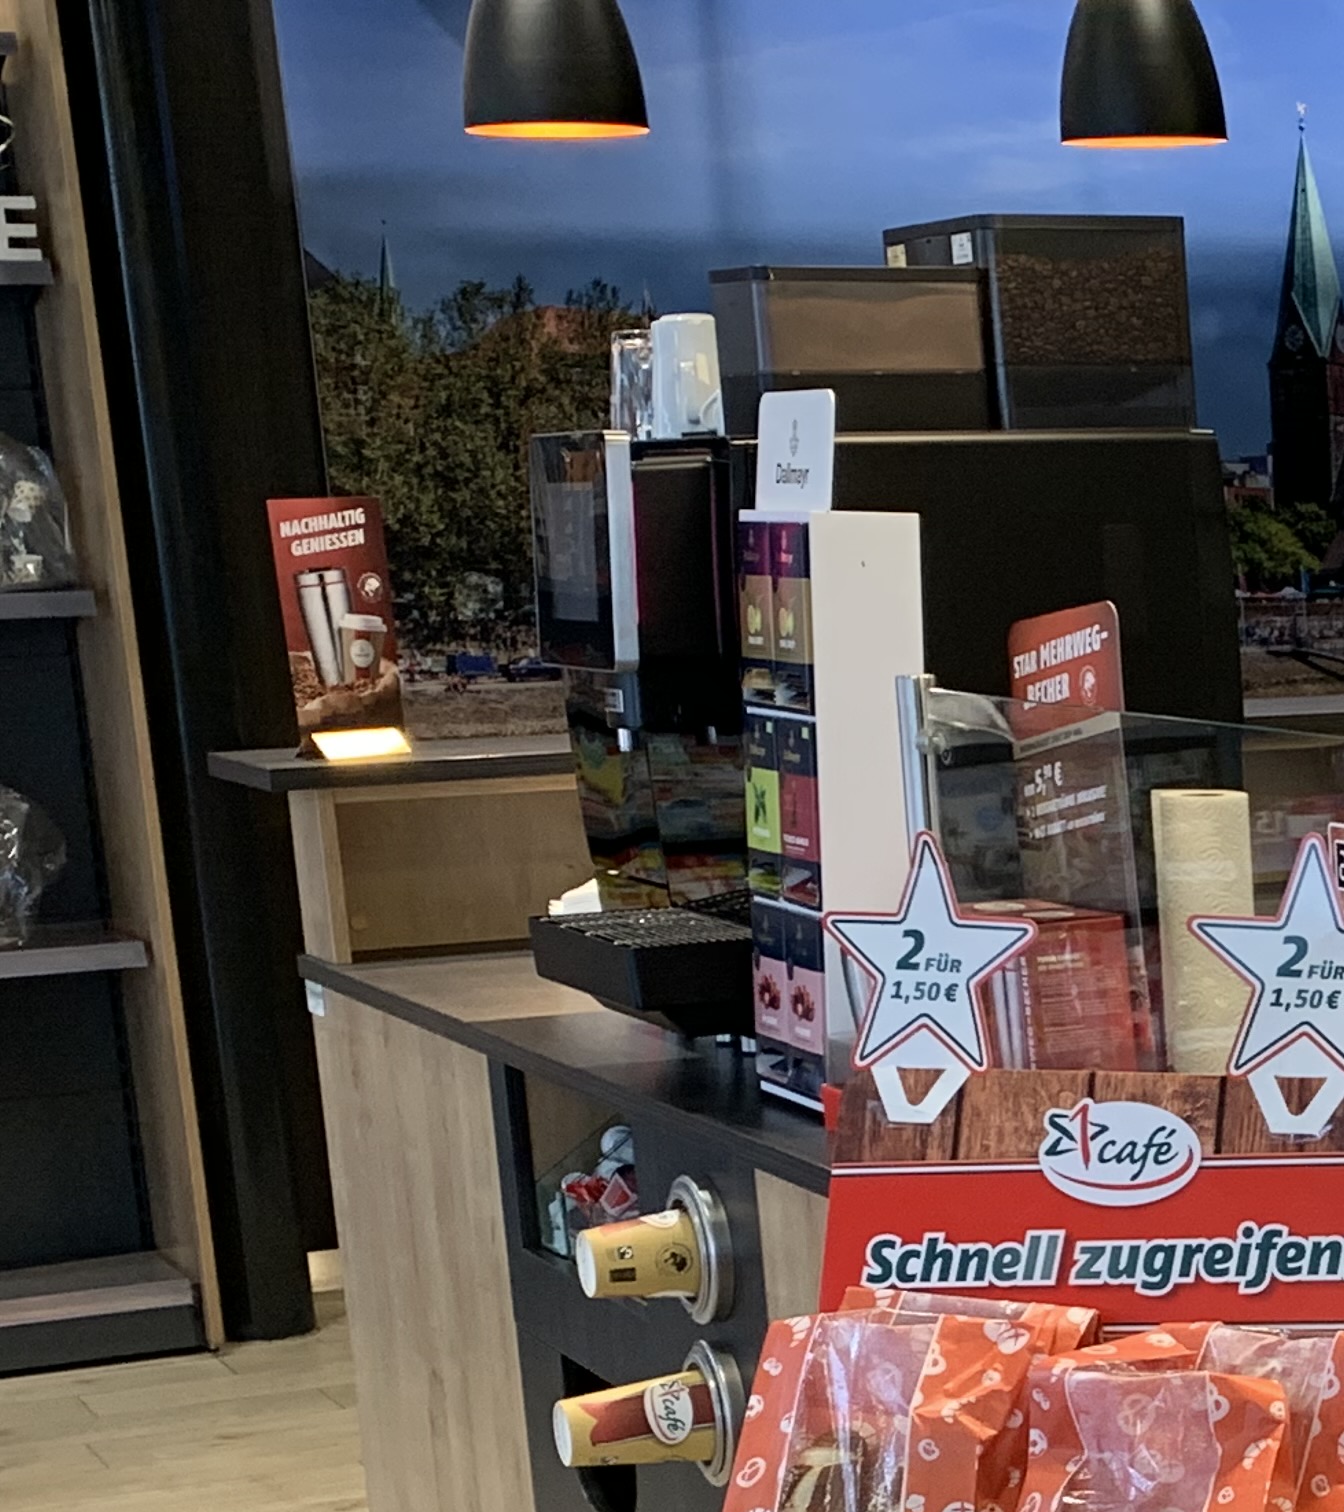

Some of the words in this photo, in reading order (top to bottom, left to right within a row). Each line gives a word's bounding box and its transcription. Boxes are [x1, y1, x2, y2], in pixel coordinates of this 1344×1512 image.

[775, 462, 811, 489] Dallmayr
[279, 508, 366, 539] NACHHALTIG
[290, 528, 365, 557] GENIESSEN
[1013, 650, 1038, 680] STAR
[1039, 623, 1109, 670] MEHRWEG-
[1023, 671, 1071, 711] BECHER
[896, 928, 926, 972] 2
[924, 952, 963, 974] FÜR
[1275, 935, 1309, 978] 2
[1100, 1126, 1179, 1181] café
[866, 1231, 1064, 1286] Schnell
[657, 1397, 687, 1437] café
